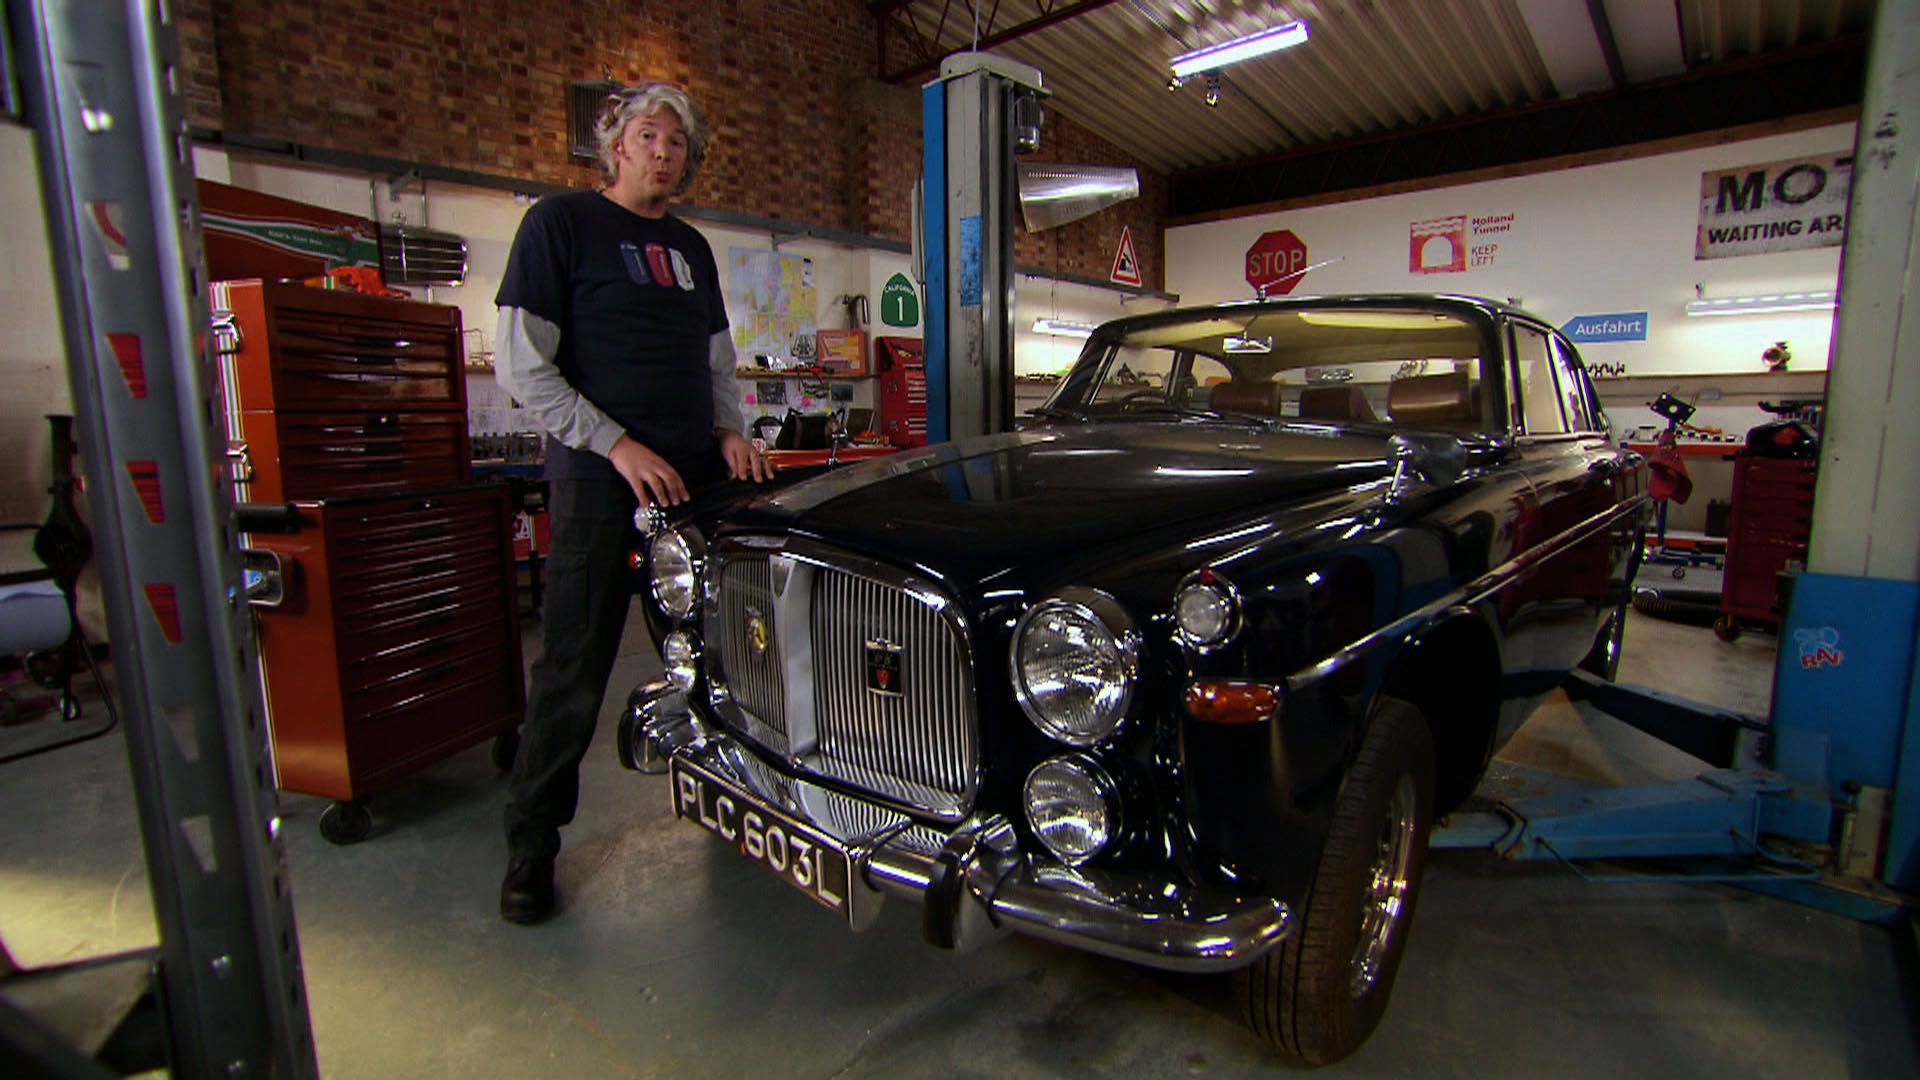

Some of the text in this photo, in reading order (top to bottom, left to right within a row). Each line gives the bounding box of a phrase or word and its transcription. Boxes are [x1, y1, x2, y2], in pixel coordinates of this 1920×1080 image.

[1472, 212, 1515, 226] Holland
[1473, 223, 1511, 235] Tunnel
[1708, 220, 1803, 245] WAITING
[1471, 244, 1498, 257] KEEP
[1249, 249, 1304, 277] STOP
[1471, 256, 1495, 267] LEFT
[897, 295, 904, 321] 1
[1575, 320, 1642, 336] Ausfahrt
[677, 769, 843, 907] PLC 603L
